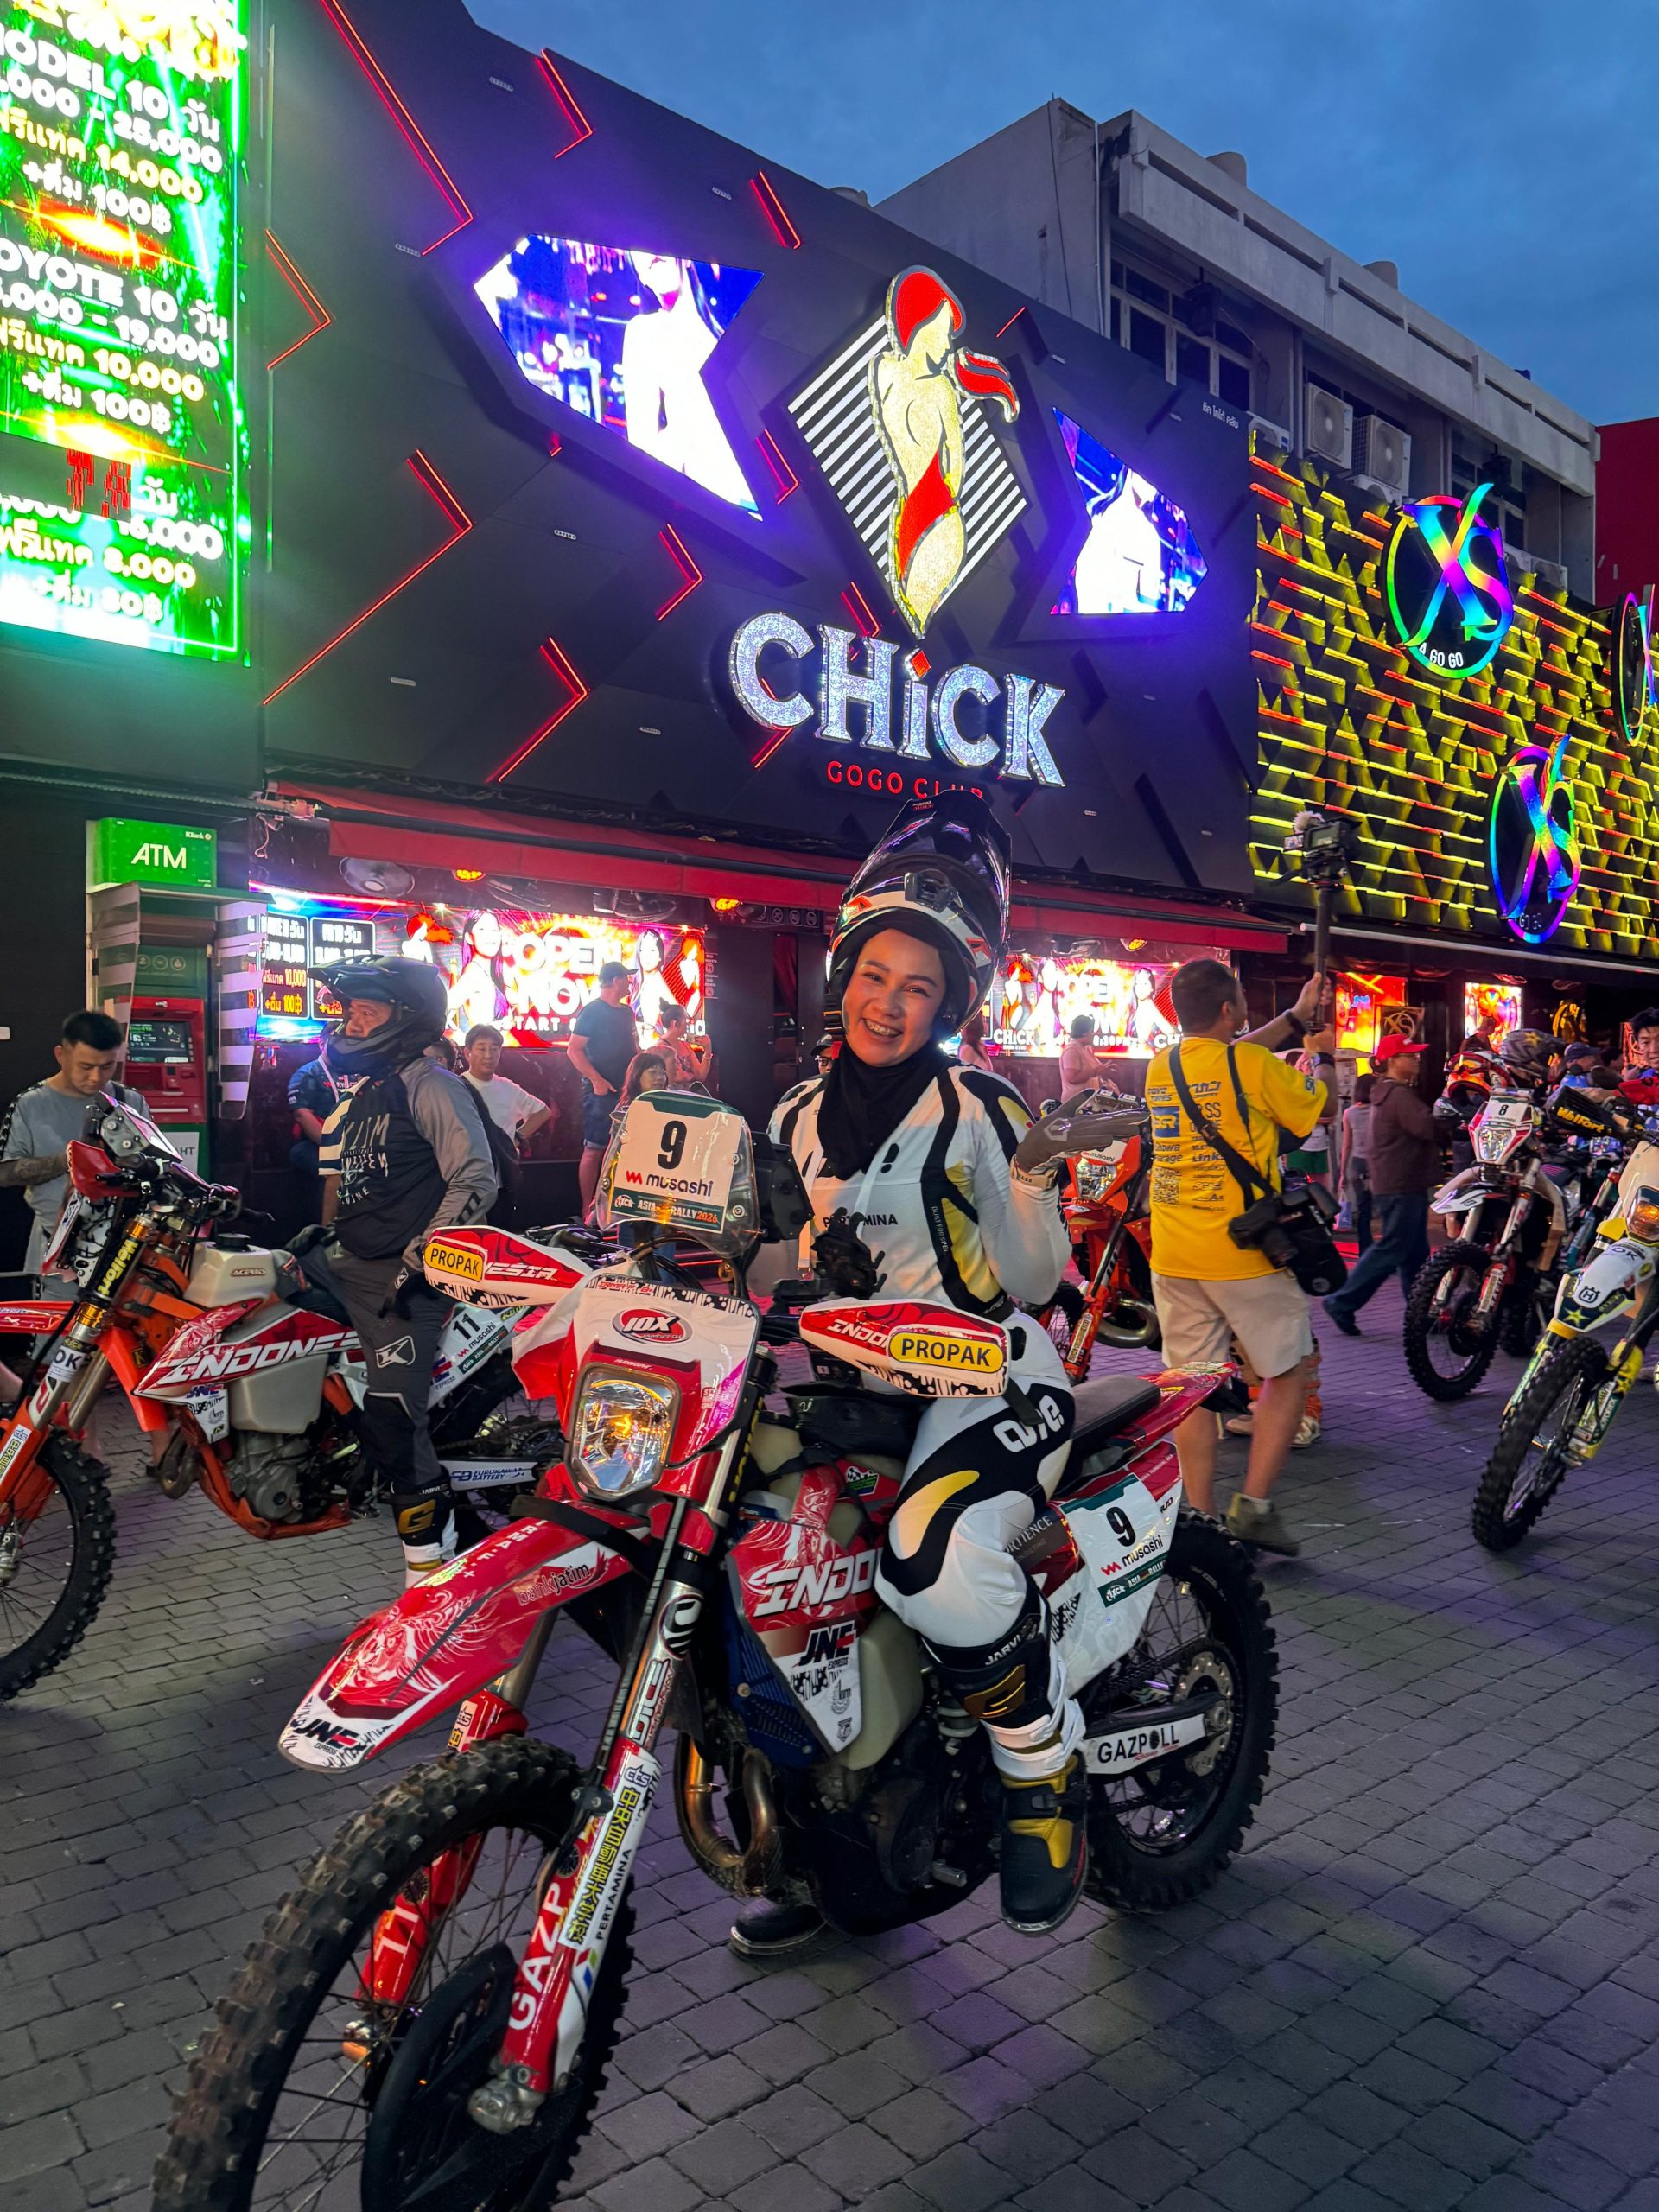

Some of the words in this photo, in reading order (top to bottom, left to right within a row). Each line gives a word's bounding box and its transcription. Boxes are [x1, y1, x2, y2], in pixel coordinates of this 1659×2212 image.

[0, 23, 116, 100] ODEL
[126, 80, 169, 119] 10
[181, 98, 219, 142] วัน
[113, 111, 222, 173] 25.000
[96, 143, 204, 204] 14.000
[134, 286, 178, 323] 10
[189, 299, 228, 340] วัน
[0, 277, 83, 326] .000
[114, 315, 219, 368] 19.000
[93, 348, 205, 402] 10.000
[137, 475, 179, 518] วัน
[1430, 647, 1446, 666] GO
[1448, 649, 1464, 668] GO
[827, 760, 904, 794] GOGO
[914, 778, 982, 798] CL
[131, 842, 187, 869] ATM
[518, 933, 622, 975] OPEN
[284, 968, 307, 988] 10,000
[1498, 1104, 1509, 1116] 8
[657, 1120, 687, 1170] 9
[1090, 1152, 1116, 1162] musashi
[646, 1173, 714, 1197] musashi
[638, 1199, 656, 1212] ASIA
[823, 1213, 898, 1228] PRMINA
[430, 1248, 480, 1276] PROPAK
[1612, 1247, 1637, 1262] OK
[453, 1313, 481, 1340] 11
[468, 1322, 496, 1349] musashi
[827, 1319, 889, 1350] INDO
[54, 1349, 84, 1370] OK
[901, 1338, 992, 1367] PROPAK
[1600, 1396, 1618, 1428] OTOREX
[1106, 1506, 1137, 1548] 9
[1122, 1534, 1164, 1567] musashi
[518, 1563, 591, 1606] bankjatim
[753, 1547, 884, 1618] INDO
[1128, 1573, 1141, 1588] ASIA
[793, 1620, 858, 1668] JNE
[297, 1718, 361, 1750] JNE
[596, 1847, 632, 1941] PERTAMINA
